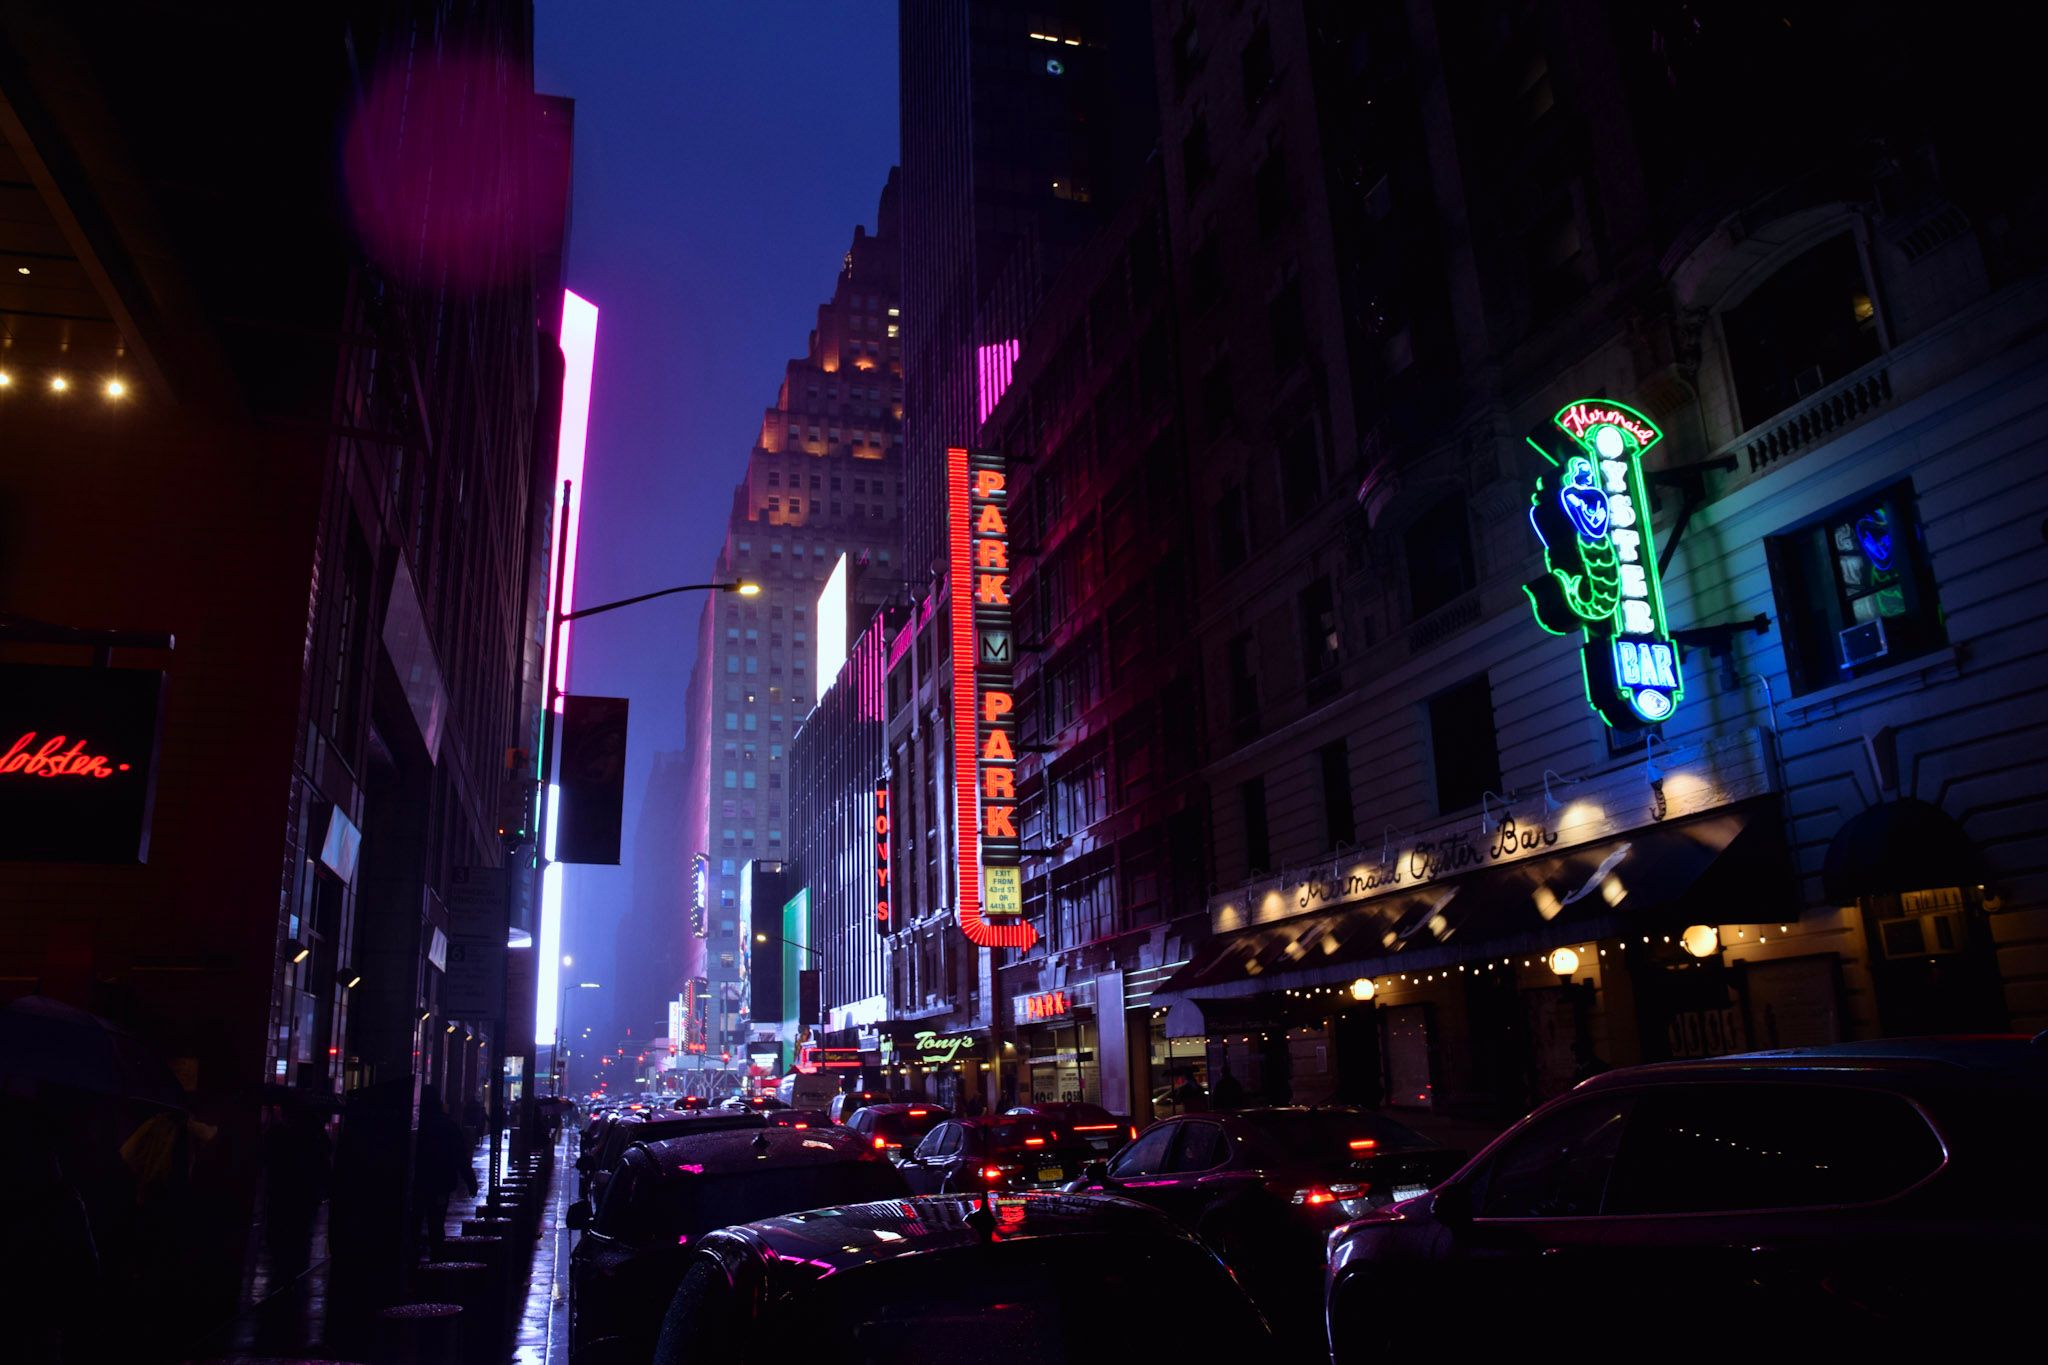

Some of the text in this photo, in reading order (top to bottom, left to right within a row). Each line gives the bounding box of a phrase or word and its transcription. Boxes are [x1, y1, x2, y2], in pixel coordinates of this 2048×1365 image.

[1564, 405, 1654, 445] Mermaid
[977, 469, 1010, 608] PARK
[1595, 426, 1655, 635] OYSTER
[1617, 641, 1677, 689] BAR
[984, 690, 1017, 839] PARK
[1300, 812, 1558, 908] Mermaid Oyster Bar
[1027, 991, 1066, 1020] PARK
[914, 1030, 976, 1063] Tony's
